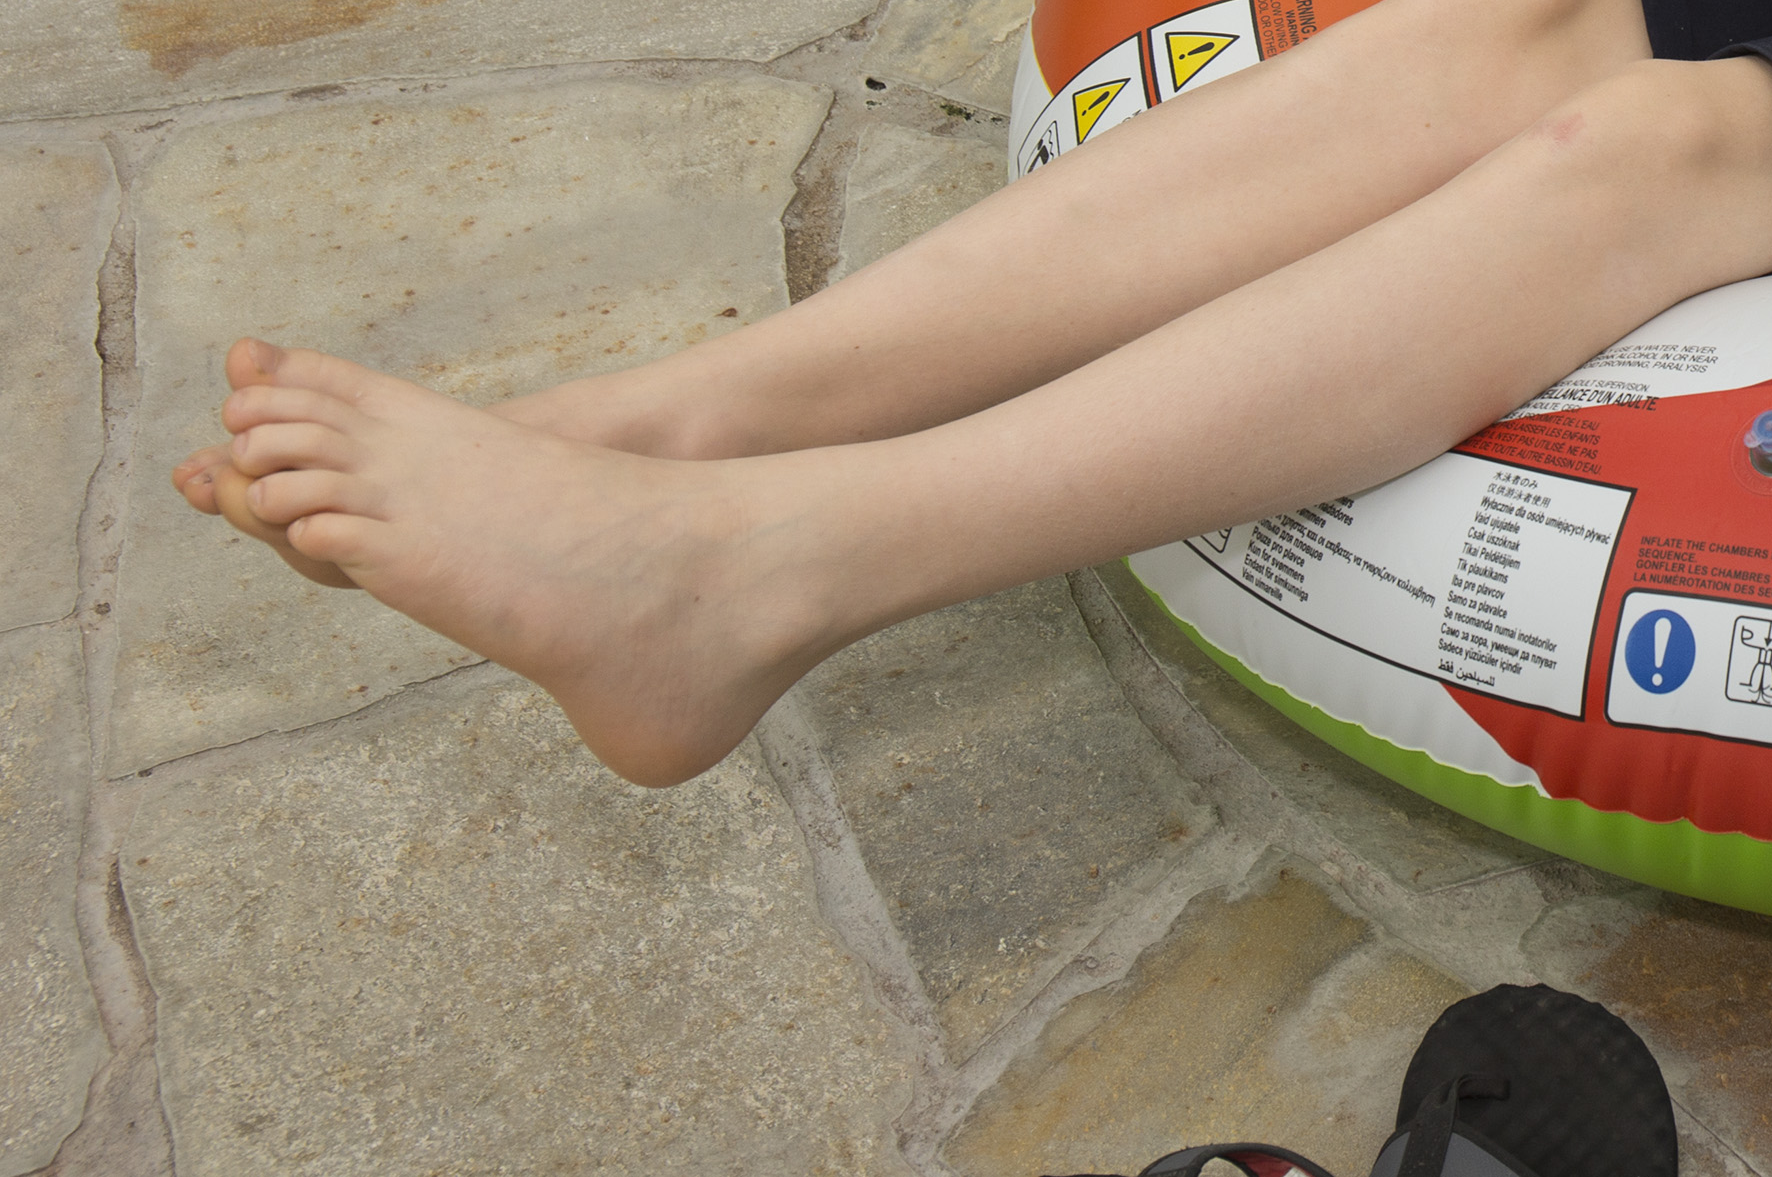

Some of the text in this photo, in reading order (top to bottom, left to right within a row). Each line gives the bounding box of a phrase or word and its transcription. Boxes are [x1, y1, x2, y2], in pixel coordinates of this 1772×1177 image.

[1260, 15, 1271, 29] OR
[1273, 17, 1288, 48] DIVING
[1285, 9, 1300, 47] WARNIN
[1680, 344, 1717, 355] NEVER
[1689, 354, 1719, 365] NEAR
[1648, 361, 1709, 374] PARALYSIS
[1587, 388, 1660, 412] D'UN ADULTE.
[1561, 431, 1601, 446] ENFANTS
[1493, 471, 1538, 489] 水泳者のみ
[1474, 511, 1491, 525] Vaid
[1515, 506, 1527, 518] dla
[1526, 511, 1545, 524] osób
[1467, 526, 1486, 541] Csak
[1252, 525, 1305, 568] Pouze pro plavce
[1462, 542, 1479, 557] Tikai
[1638, 548, 1697, 563] SEQUENCE.
[1640, 536, 1683, 549] INFLATE
[1686, 540, 1706, 552] THE
[1708, 542, 1769, 559] CHAMBERS
[1457, 558, 1509, 584] Tik plaukikams
[1636, 559, 1686, 573] GONFLER
[1688, 564, 1708, 576] LES
[1710, 567, 1771, 584] CHAMBRES
[1451, 574, 1505, 600] Iba pre plavcov
[1633, 572, 1647, 582] LA
[1649, 573, 1731, 592] NUMÉROTATION
[1733, 583, 1755, 595] DES
[1447, 590, 1508, 619] Samo za plavalce
[1444, 606, 1557, 652] Se recomanda numai inotatorilor
[1438, 638, 1523, 675] Sadece yüzücüler içindir
[1441, 622, 1460, 638] Само
[1461, 631, 1469, 641] за
[1470, 634, 1488, 648] хора,
[1519, 651, 1530, 661] да
[1531, 654, 1557, 670] плуват
